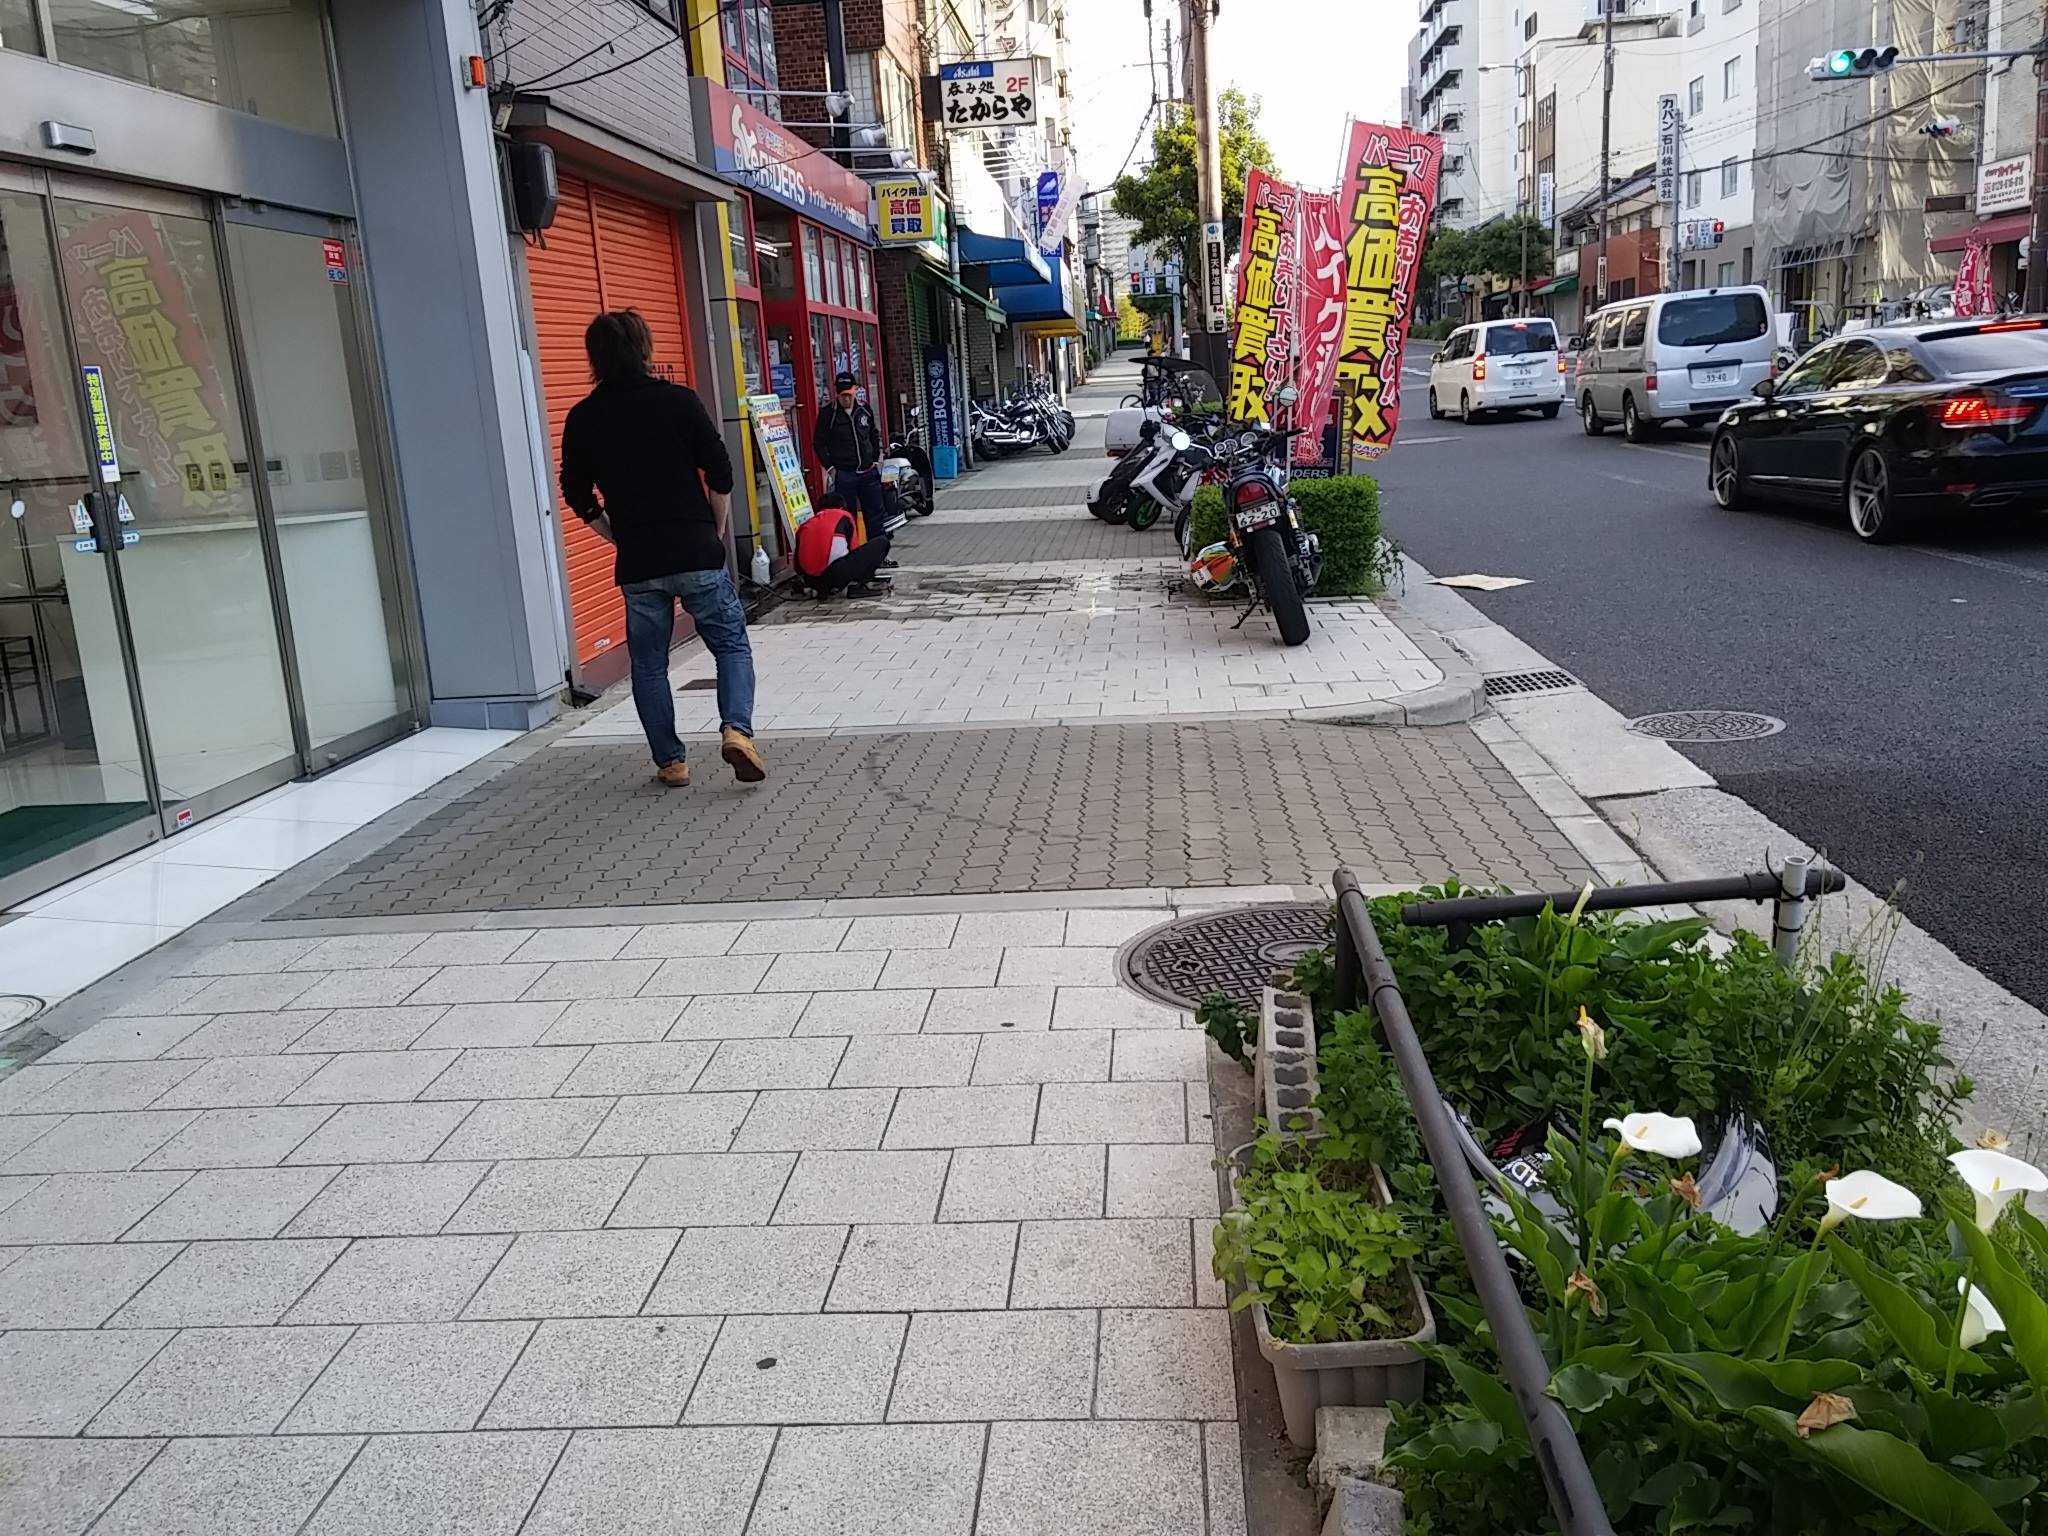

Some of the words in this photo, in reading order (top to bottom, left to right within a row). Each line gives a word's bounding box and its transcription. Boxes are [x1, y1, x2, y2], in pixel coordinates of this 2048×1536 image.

[953, 65, 981, 79] Asahi
[947, 80, 995, 97] 呑み処
[1006, 77, 1029, 92] 2F
[946, 93, 1032, 123] たからや
[1361, 134, 1433, 180] パーツ
[881, 186, 928, 198] バイク用品
[890, 198, 921, 215] 高価
[1256, 181, 1297, 222] パーツ
[891, 217, 922, 234] 買取
[1336, 165, 1404, 439] 高価買取
[1228, 207, 1282, 422] 高価買取
[931, 379, 947, 419] BOSS
[1284, 468, 1329, 478] IDERS
[1240, 507, 1277, 526] 62-20
